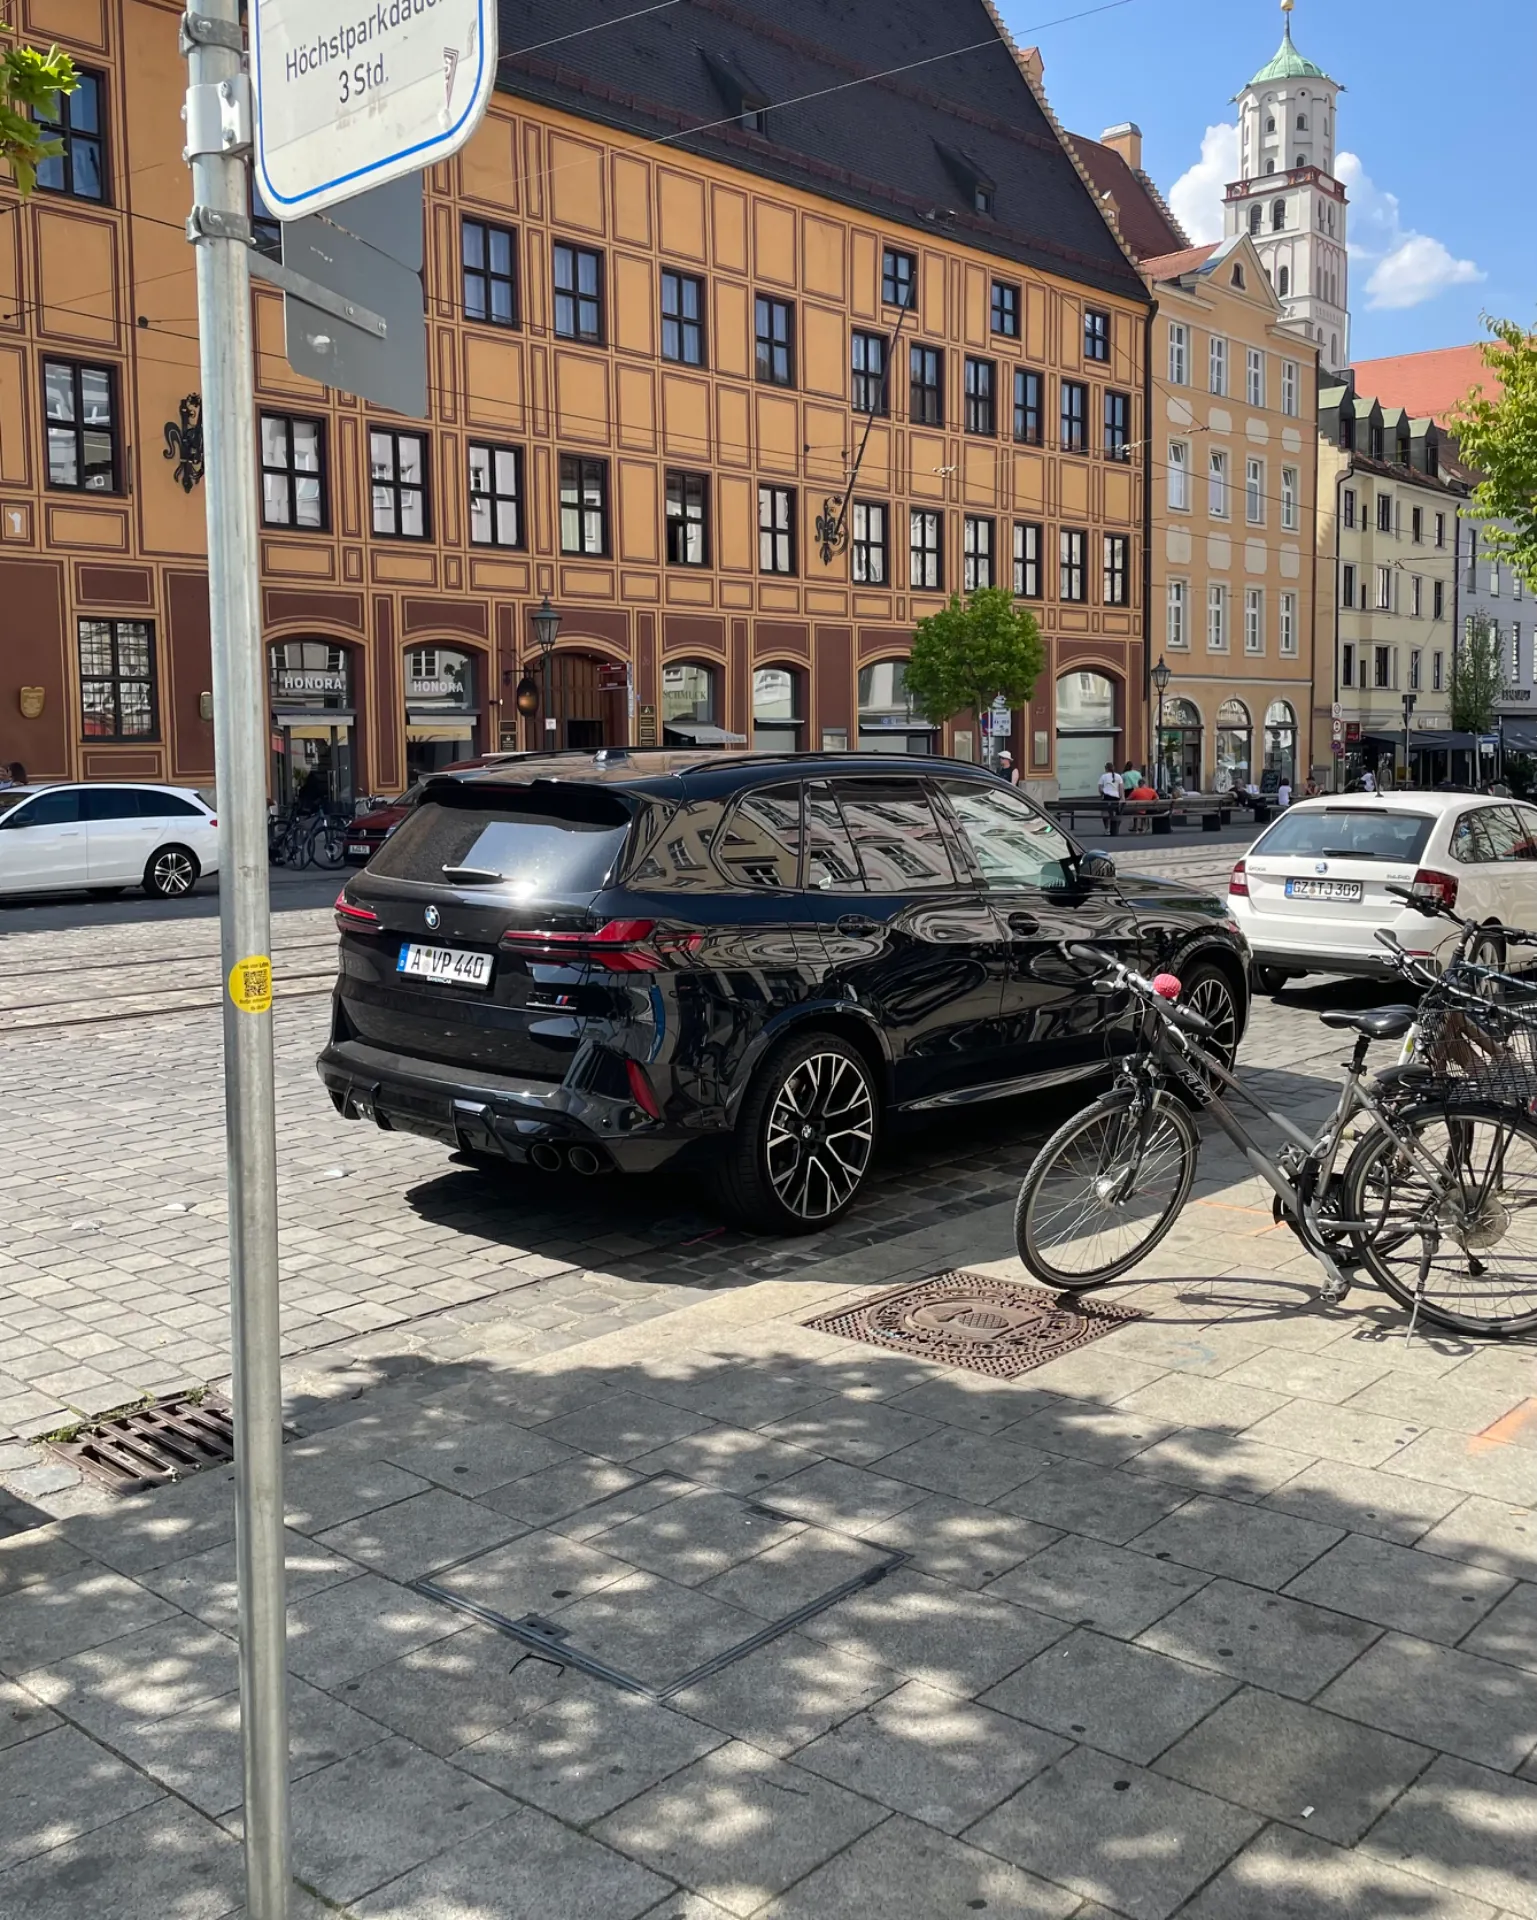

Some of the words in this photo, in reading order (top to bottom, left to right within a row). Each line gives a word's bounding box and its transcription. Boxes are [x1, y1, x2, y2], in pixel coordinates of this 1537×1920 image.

[286, 0, 443, 82] Höchstparkdau
[338, 69, 349, 104] 3
[354, 53, 389, 96] Std.
[284, 677, 343, 690] HONORA
[413, 681, 464, 693] HONORA
[1293, 881, 1308, 894] GZ
[1318, 882, 1332, 895] TJ
[1335, 883, 1359, 897] 309
[410, 948, 422, 971] A
[432, 950, 452, 973] VP
[454, 954, 484, 979] 440
[1176, 1069, 1213, 1106] KTM
